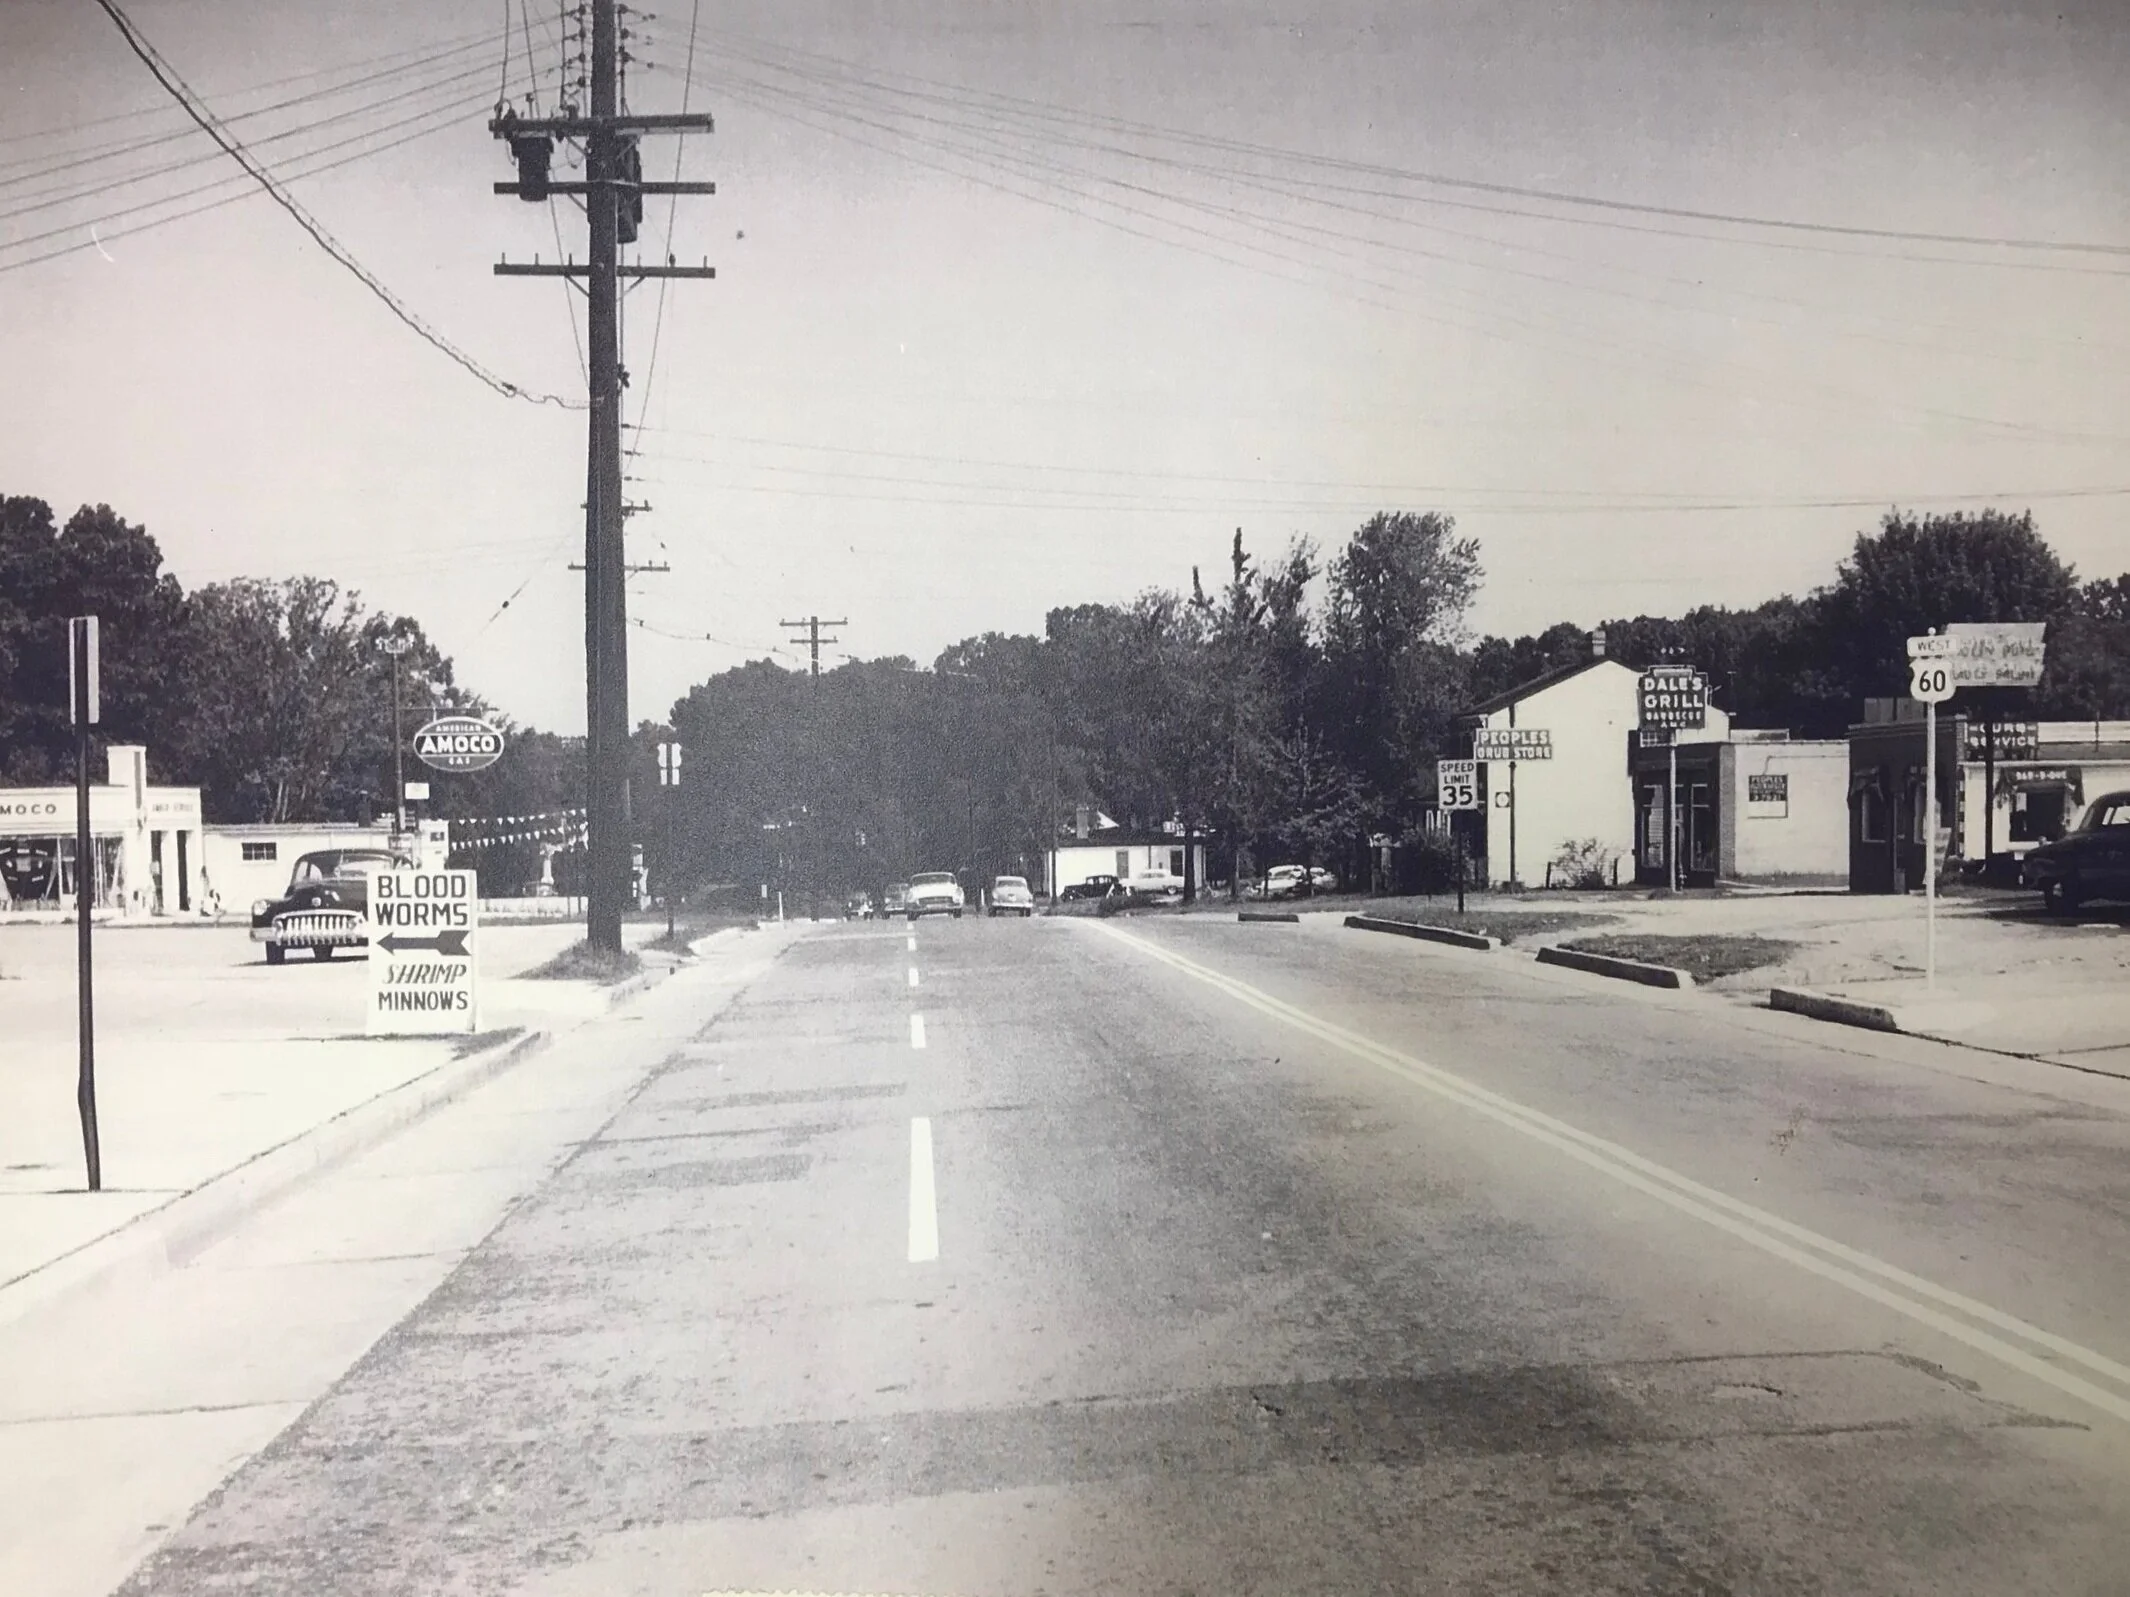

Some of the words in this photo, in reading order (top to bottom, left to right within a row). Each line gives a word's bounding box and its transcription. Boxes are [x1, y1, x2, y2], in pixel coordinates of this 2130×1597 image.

[1917, 640, 1950, 652] WEST
[1919, 669, 1946, 692] 60
[1644, 694, 1704, 708] GRILL
[421, 735, 495, 753] AMOCO
[1480, 731, 1549, 745] PEOPLES
[1477, 747, 1509, 759] DRUG
[1514, 747, 1551, 759] STORE
[1441, 763, 1475, 773] SPEED
[1444, 774, 1470, 784] LIMIT
[1443, 785, 1473, 806] 35
[0, 803, 57, 815] MOCO
[378, 875, 467, 898] BLOOD
[375, 902, 468, 926] WORMS
[382, 964, 468, 984] SHRIMP
[378, 991, 468, 1011] MINNOWS
